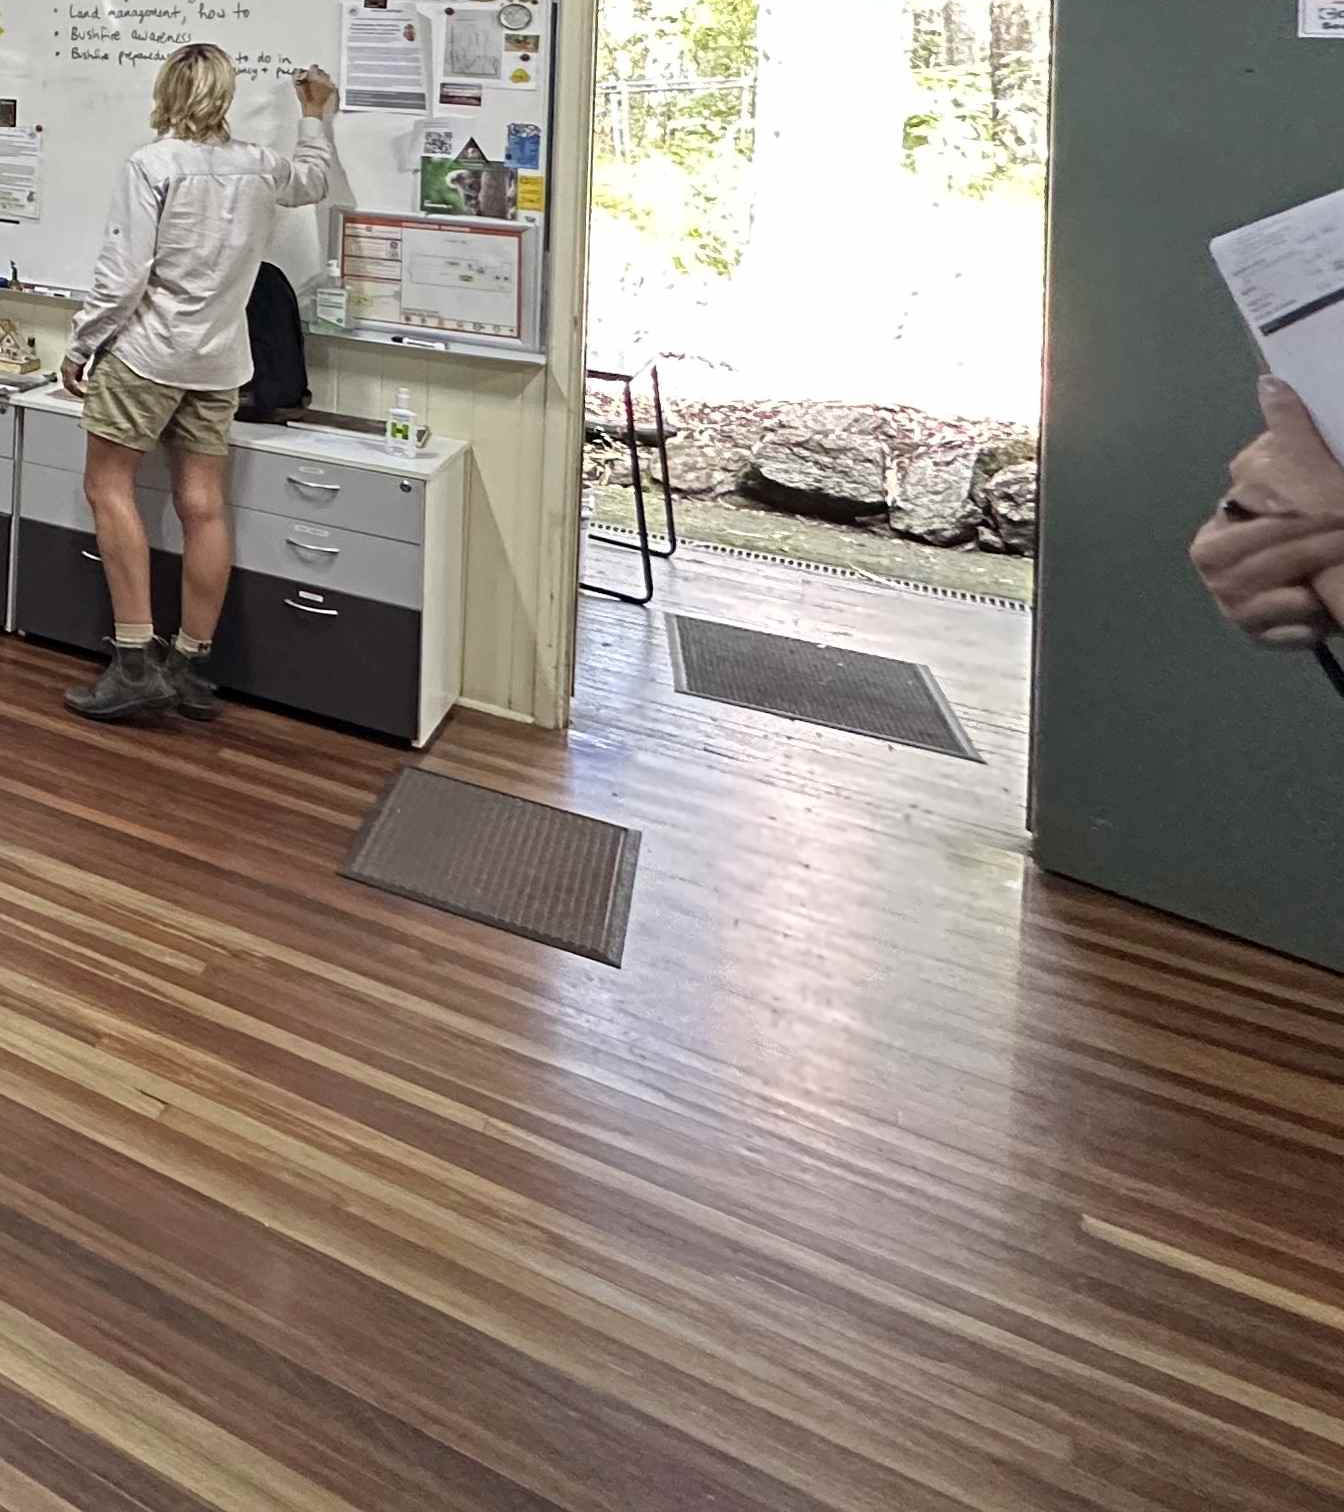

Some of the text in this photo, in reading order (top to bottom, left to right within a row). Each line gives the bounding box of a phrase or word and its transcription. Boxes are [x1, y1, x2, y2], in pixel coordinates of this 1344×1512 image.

[69, 5, 101, 19] Land
[199, 5, 226, 19] how
[233, 3, 250, 19] to
[70, 27, 121, 41] Bushfire
[235, 51, 292, 64] to do in
